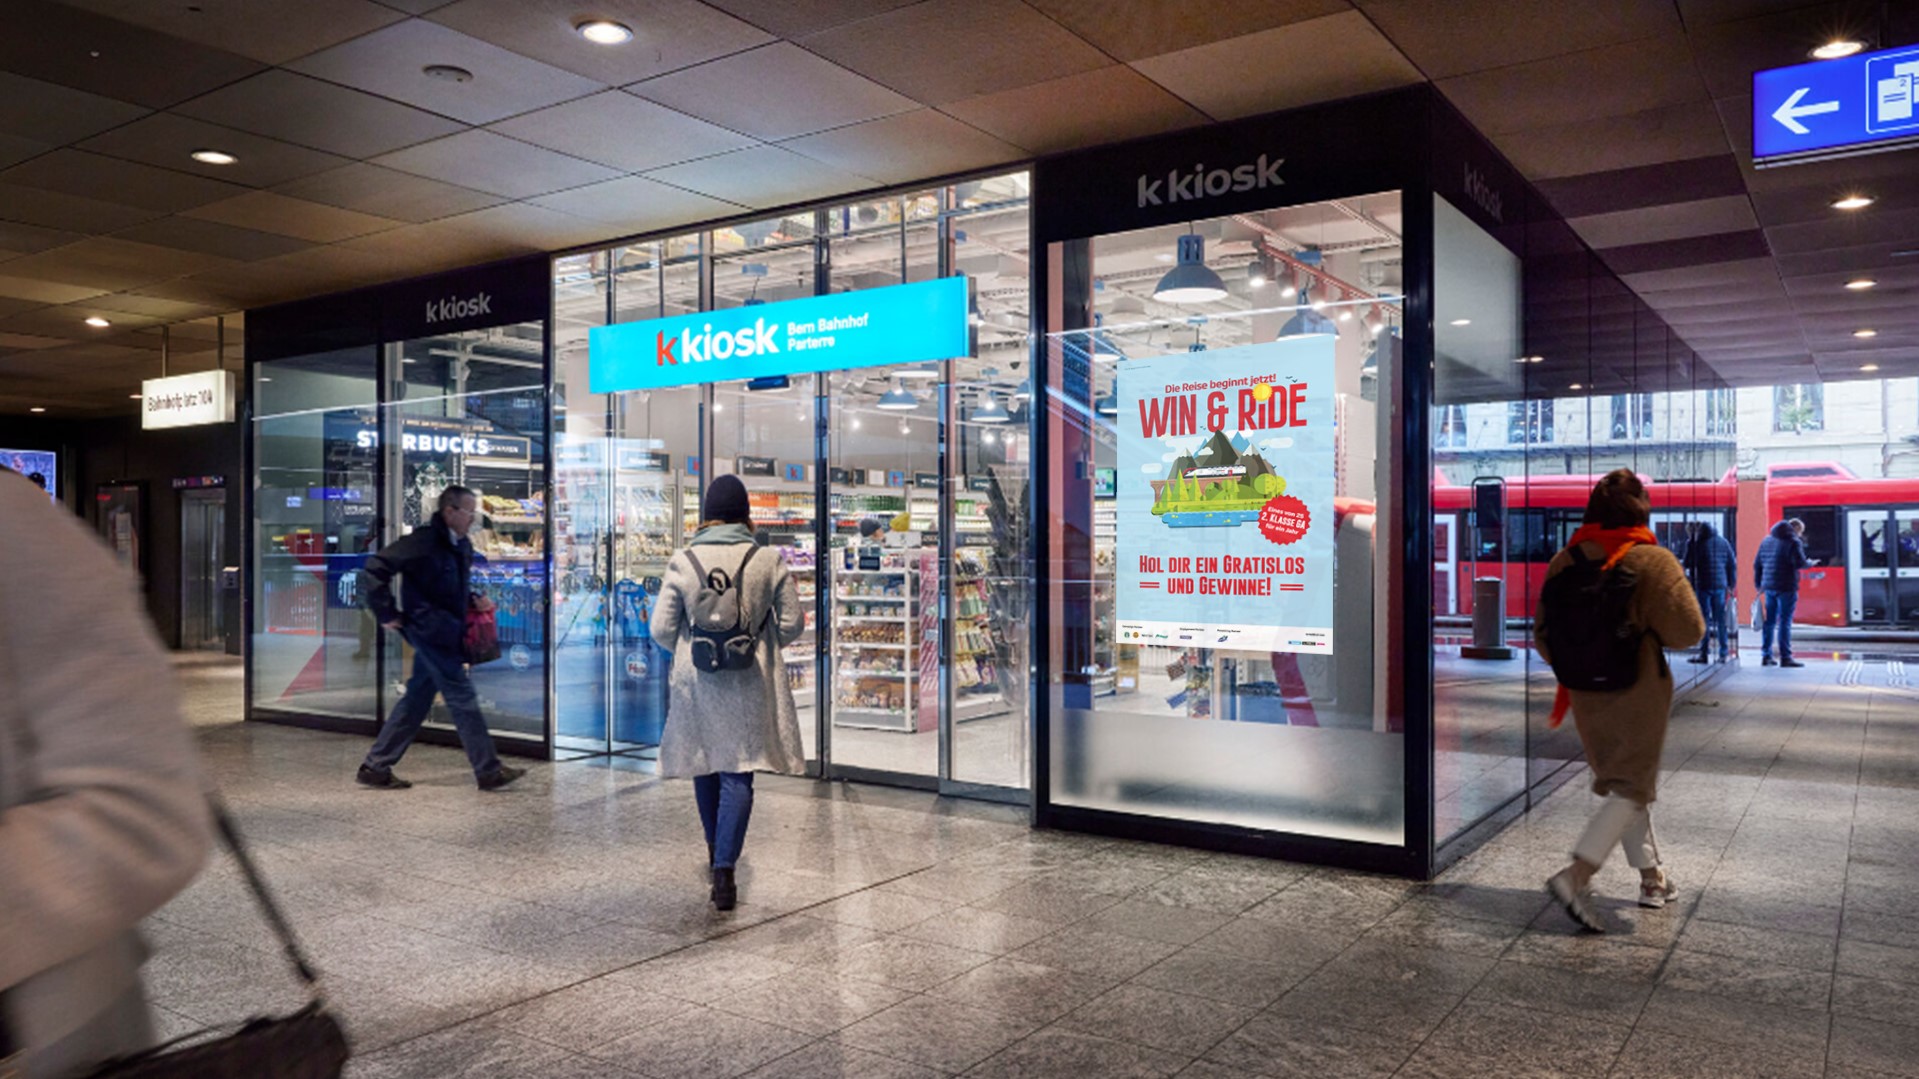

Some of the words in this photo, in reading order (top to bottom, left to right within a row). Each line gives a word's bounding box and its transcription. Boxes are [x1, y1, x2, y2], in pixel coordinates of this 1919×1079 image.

[1138, 174, 1162, 208] k
[1168, 153, 1285, 203] kiosk
[426, 301, 438, 323] k
[440, 292, 491, 320] kiosk
[656, 330, 678, 366] k
[682, 317, 780, 364] kiosk
[787, 321, 815, 336] Bern
[818, 312, 869, 333] Bahnhof
[787, 335, 836, 352] Parterre
[1165, 384, 1180, 394] Die
[1182, 380, 1208, 392] Reise
[1210, 377, 1248, 390] beginnt
[1250, 373, 1277, 386] jetzt!
[1139, 394, 1197, 438] WIN
[1207, 391, 1229, 433] &
[357, 430, 489, 455] STRBUCKS
[1261, 511, 1268, 521] 2.
[1269, 514, 1295, 527] KLASSE
[1296, 519, 1306, 529] GA
[1139, 555, 1164, 573] HOL
[1168, 557, 1191, 573] DIR
[1196, 557, 1218, 574] EIN
[1223, 555, 1305, 574] GRATISLOS
[1168, 577, 1194, 594] UND
[1199, 576, 1271, 596] GEWINNE!
